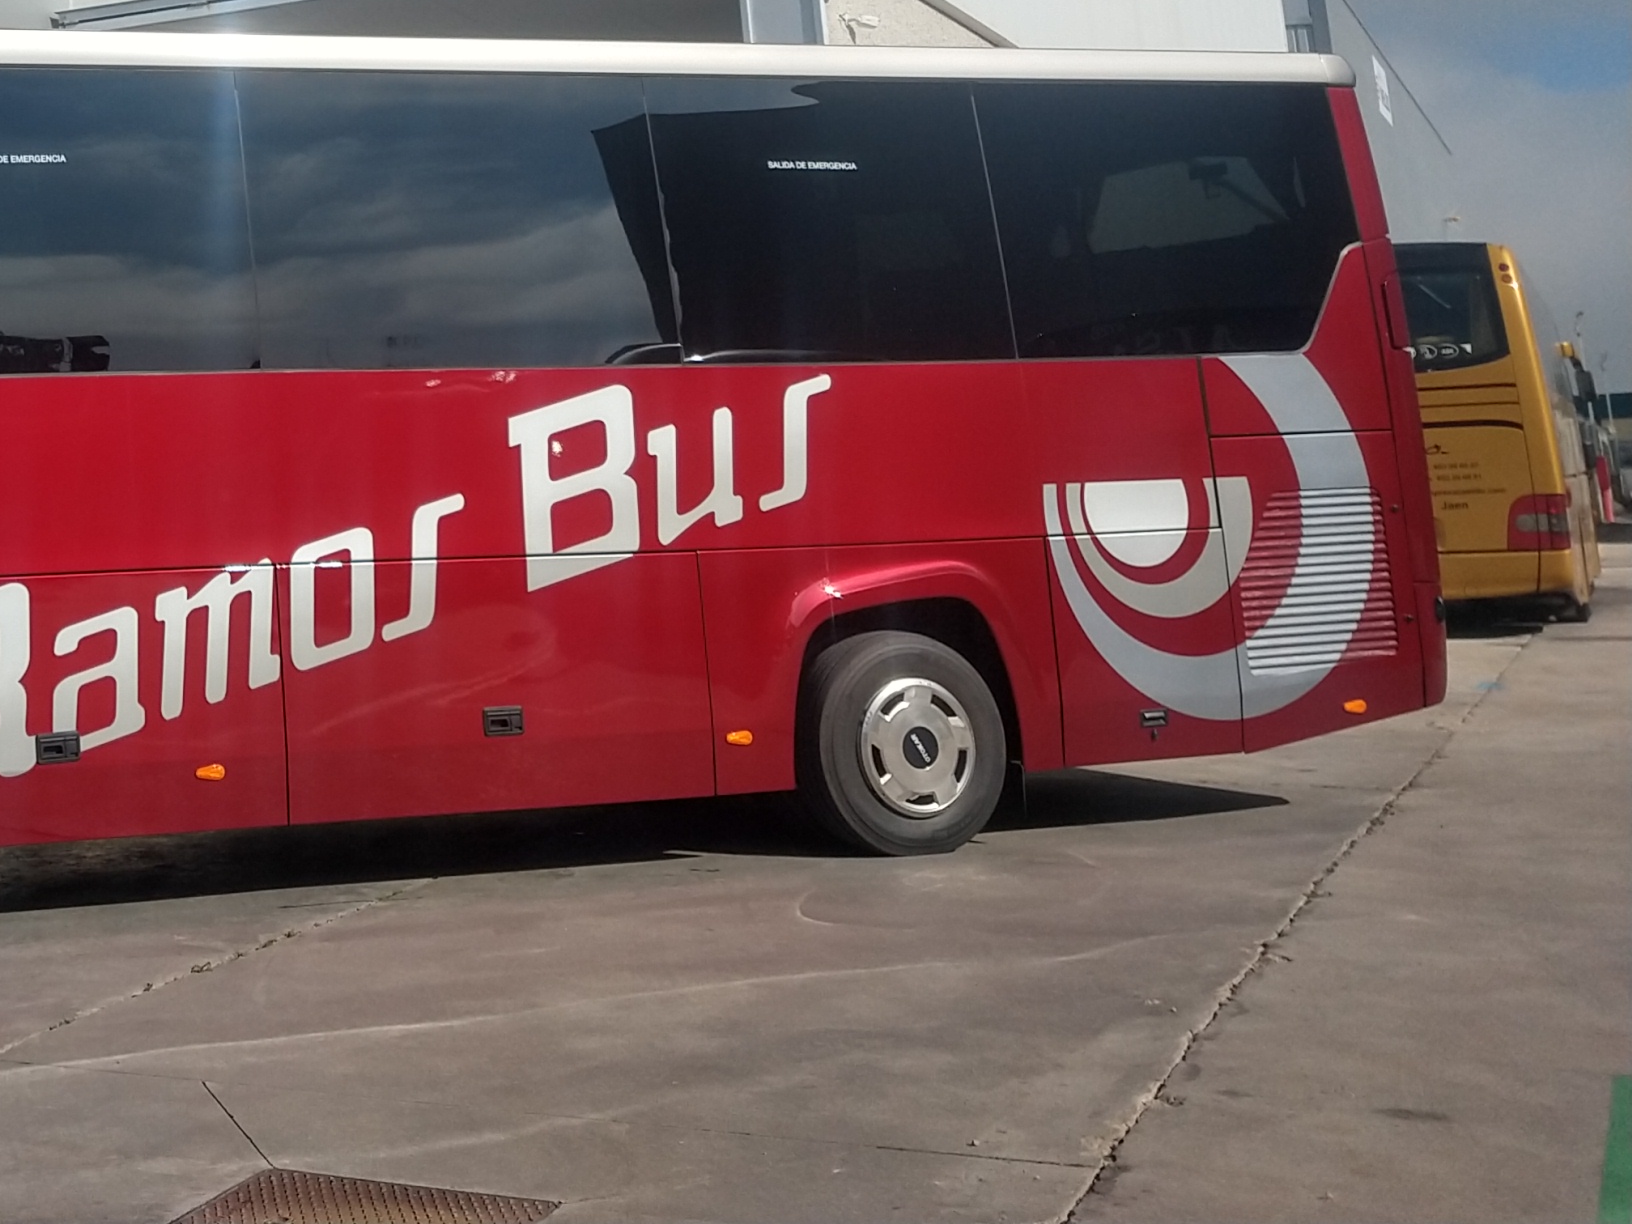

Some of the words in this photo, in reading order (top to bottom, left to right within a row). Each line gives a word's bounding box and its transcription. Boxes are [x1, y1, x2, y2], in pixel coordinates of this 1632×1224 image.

[10, 155, 67, 163] EMERGENCIA
[767, 160, 795, 169] SALIDA
[796, 161, 807, 170] DE
[808, 161, 858, 170] EMERGENCIA
[508, 374, 832, 591] Bus
